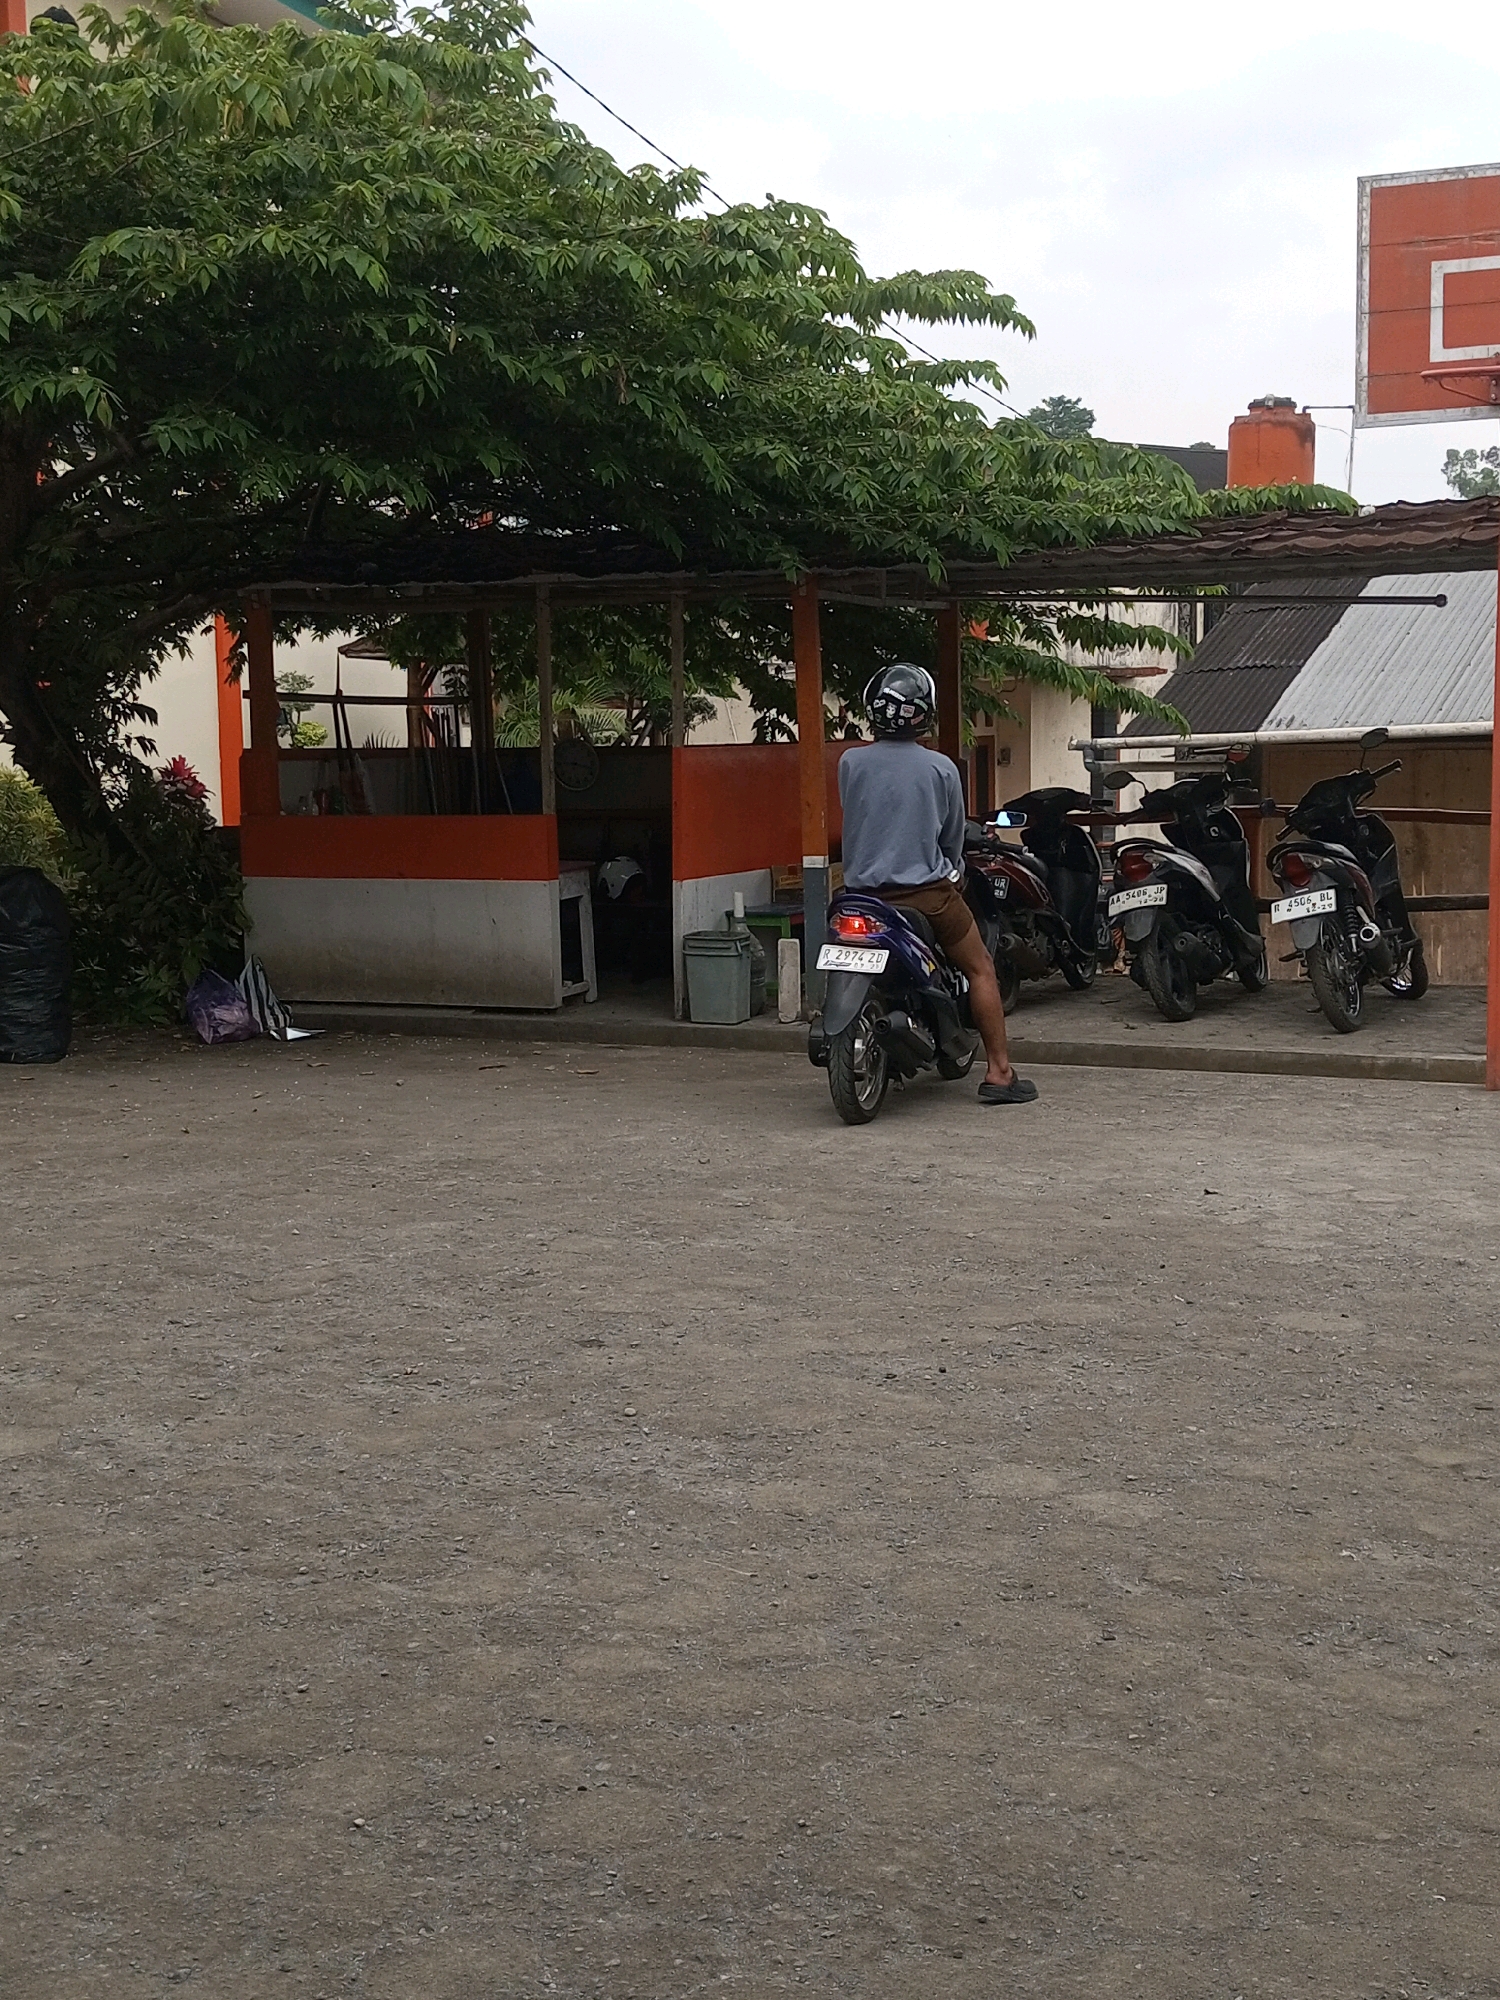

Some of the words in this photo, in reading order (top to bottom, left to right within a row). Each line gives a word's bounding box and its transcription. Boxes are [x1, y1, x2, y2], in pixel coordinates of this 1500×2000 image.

[1110, 895, 1121, 906] AA
[1154, 886, 1165, 895] JP
[1274, 903, 1280, 913] R
[1288, 895, 1312, 908] 4506
[1320, 892, 1333, 902] BL
[823, 948, 831, 959] R
[835, 949, 866, 961] 2974
[868, 952, 884, 964] ZD
